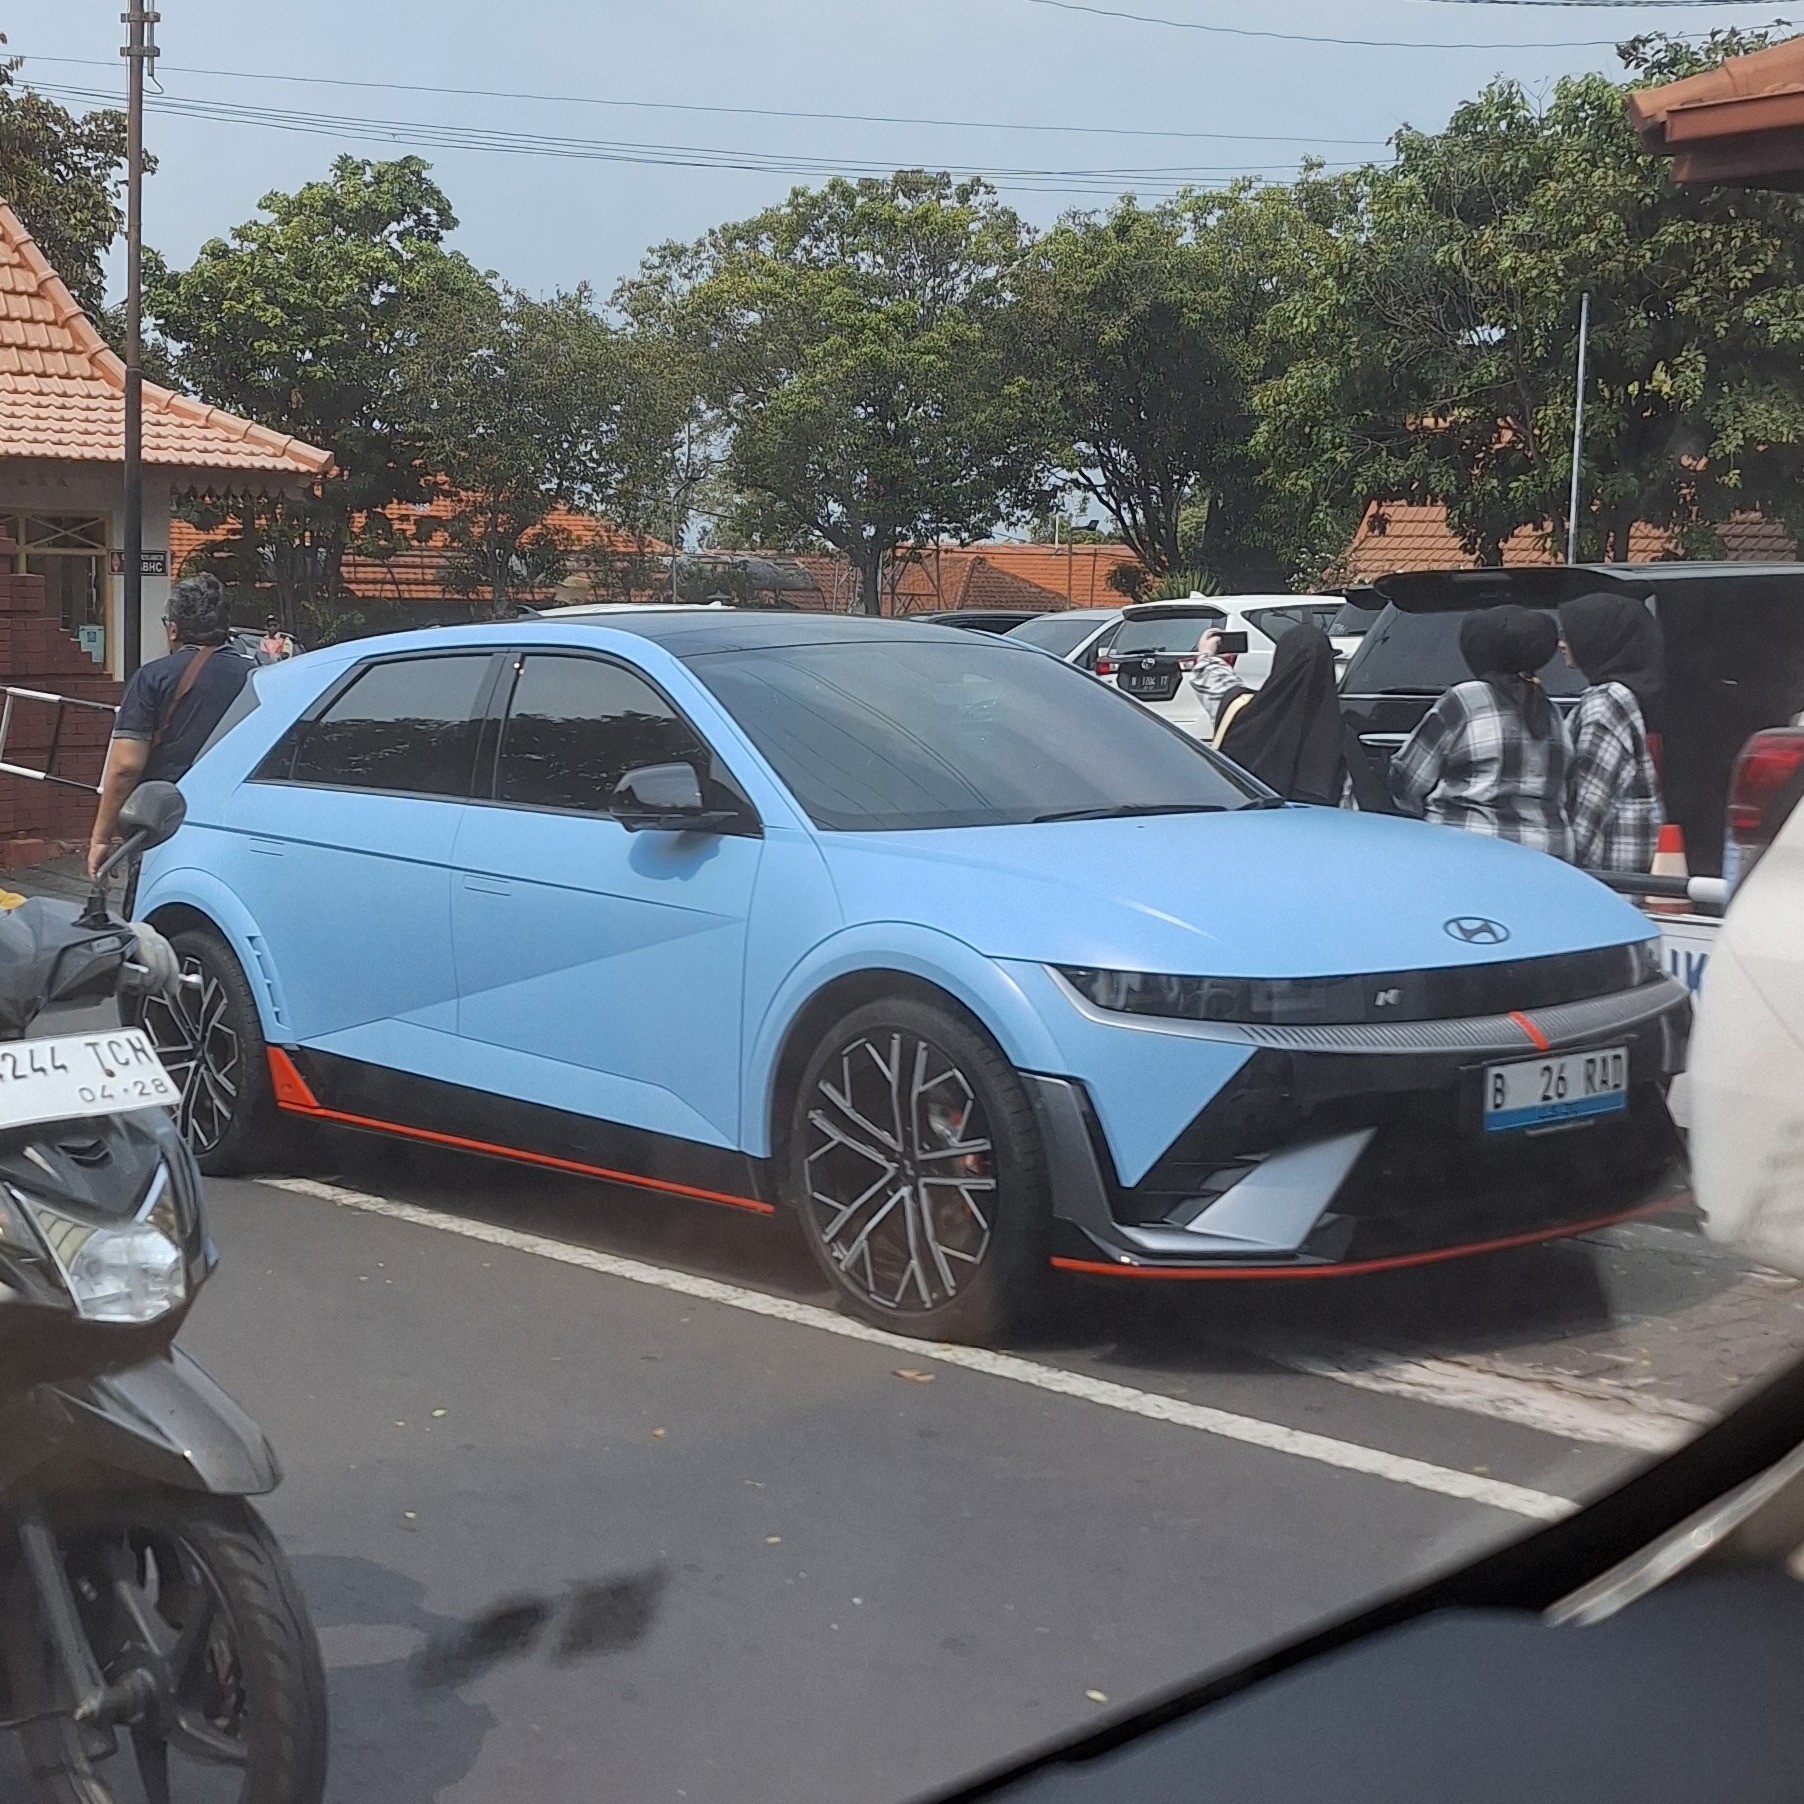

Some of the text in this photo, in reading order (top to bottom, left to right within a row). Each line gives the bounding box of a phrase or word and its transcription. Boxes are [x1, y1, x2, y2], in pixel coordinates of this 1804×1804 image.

[0, 1045, 68, 1081] 244
[1493, 1073, 1505, 1109] B
[1540, 1062, 1567, 1101] 26
